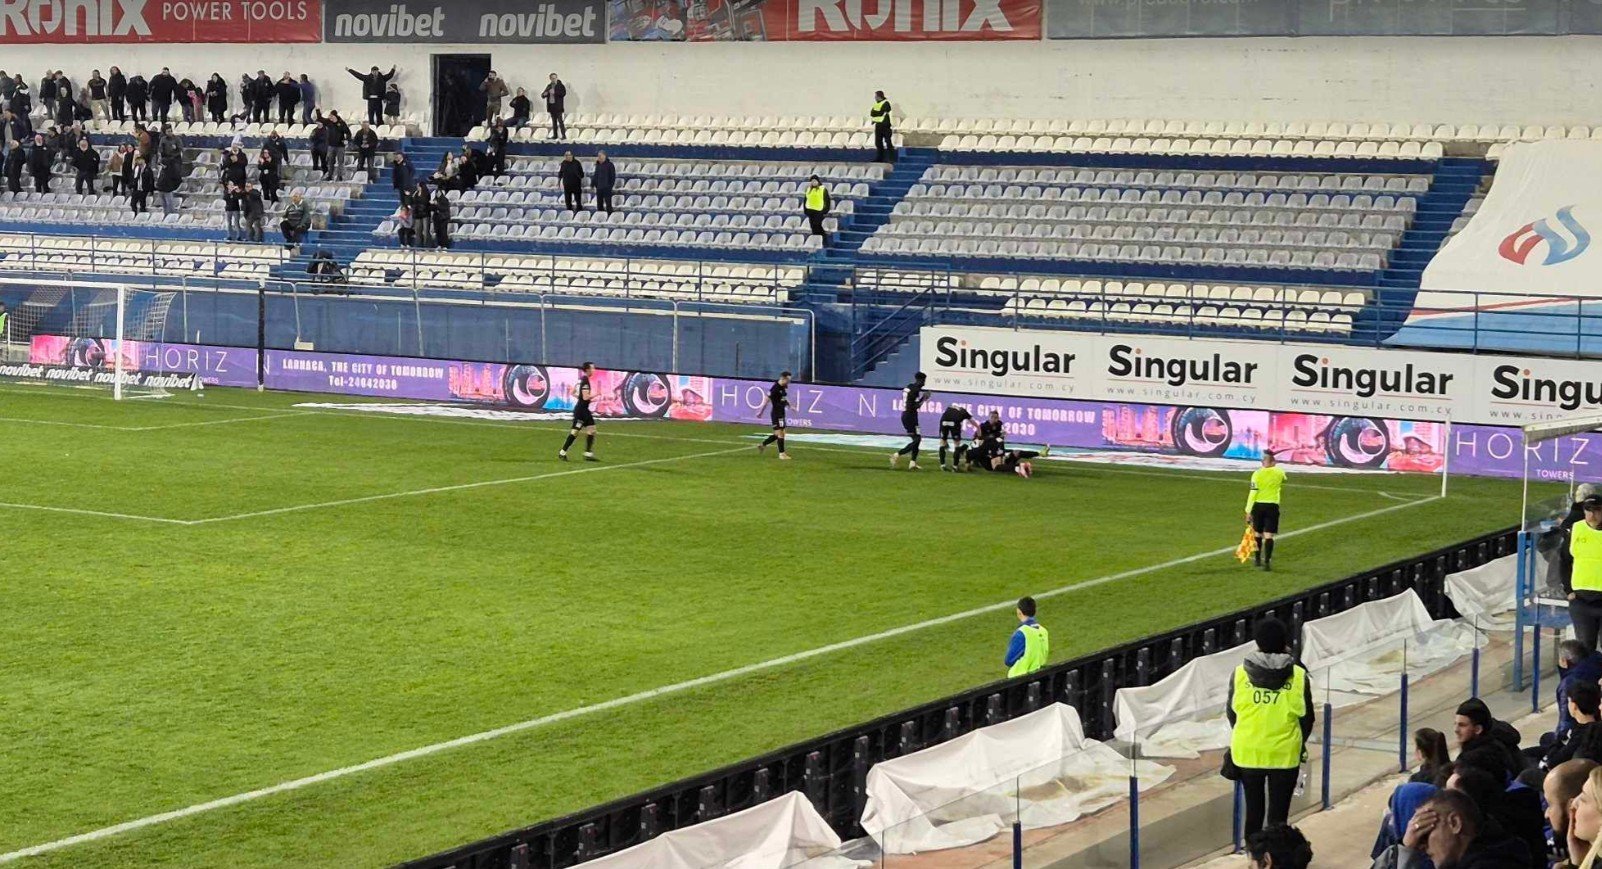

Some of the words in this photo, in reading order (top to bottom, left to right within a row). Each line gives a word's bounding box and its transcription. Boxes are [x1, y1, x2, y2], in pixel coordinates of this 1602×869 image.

[163, 2, 232, 20] POWER
[242, 1, 307, 20] TOOLS
[335, 5, 445, 37] novibet
[479, 5, 596, 37] novibet
[146, 348, 228, 372] HORIZ
[935, 336, 1075, 376] Singular
[1108, 344, 1258, 386] Singular
[0, 364, 43, 378] novibet
[45, 367, 93, 381] novibet
[144, 373, 192, 388] novibet
[331, 361, 350, 373] THE
[352, 363, 372, 375] CITY
[376, 364, 388, 375] OF
[390, 365, 444, 379] TOMORROW
[1292, 354, 1453, 398] Singular
[933, 377, 1075, 393] www.singular.com.cy
[722, 384, 824, 414] HOIZ
[858, 393, 876, 418] N
[1106, 387, 1256, 404] www.singular.com.cy
[1009, 408, 1023, 419] OF
[1027, 408, 1096, 424] TOMORROW
[1291, 398, 1452, 415] www.singular.com.cy
[1536, 468, 1575, 480] TOWERS
[1253, 690, 1280, 704] 057
